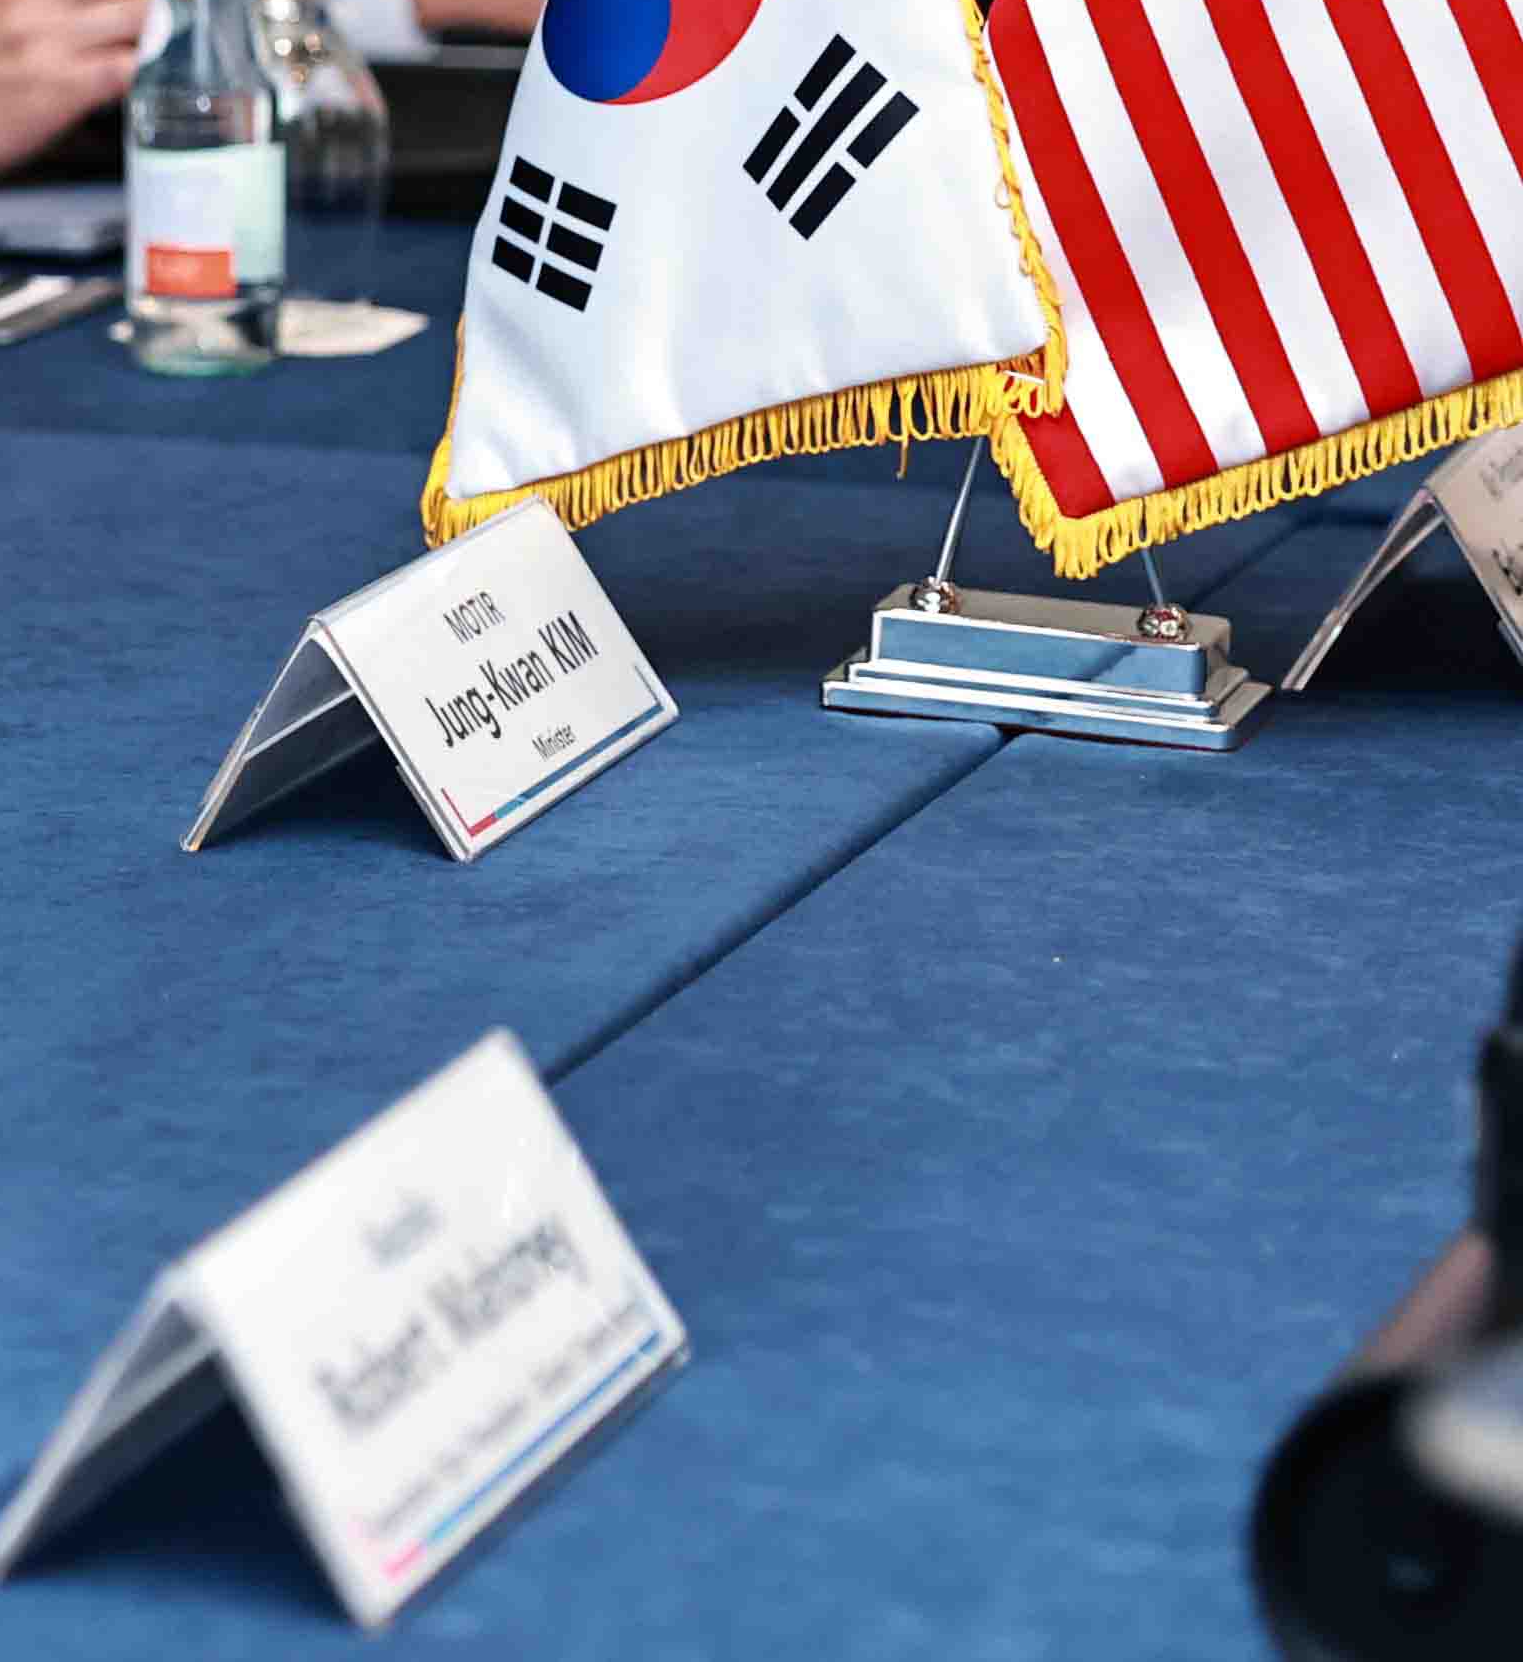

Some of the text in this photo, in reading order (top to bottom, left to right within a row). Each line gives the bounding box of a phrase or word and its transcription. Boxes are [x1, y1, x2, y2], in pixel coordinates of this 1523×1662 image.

[443, 590, 506, 644] MOTIR
[424, 609, 600, 747] Jung-Kwan KIM
[531, 724, 577, 759] Minister
